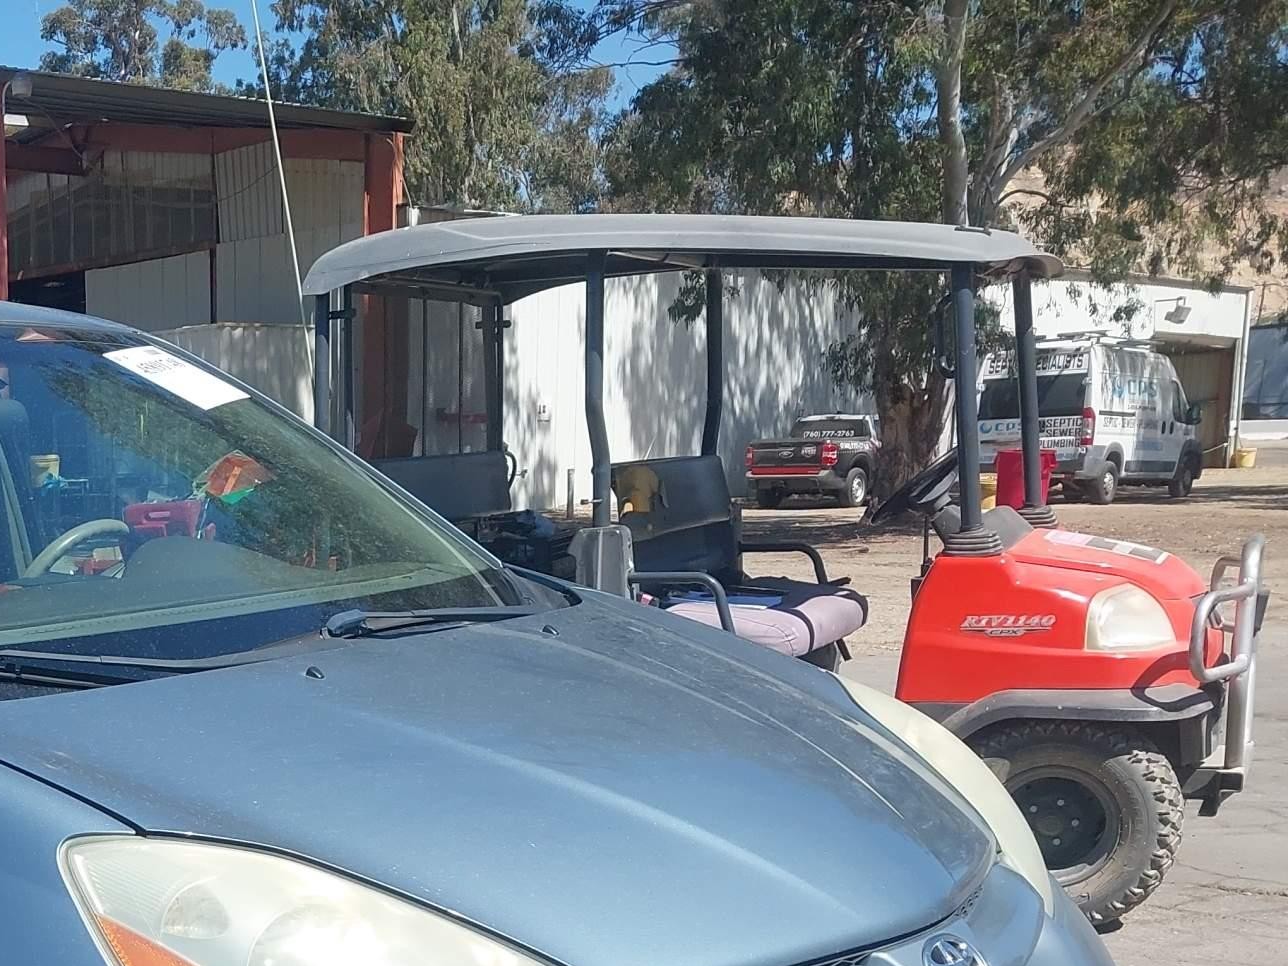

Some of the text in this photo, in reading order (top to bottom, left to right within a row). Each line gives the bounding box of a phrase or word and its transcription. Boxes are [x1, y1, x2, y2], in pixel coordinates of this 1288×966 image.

[1036, 353, 1084, 370] ECIALISTS
[1046, 418, 1083, 428] SEPTIC
[803, 430, 821, 440] (760)
[1046, 428, 1082, 438] SEWER
[960, 614, 1056, 628] RTV1140
